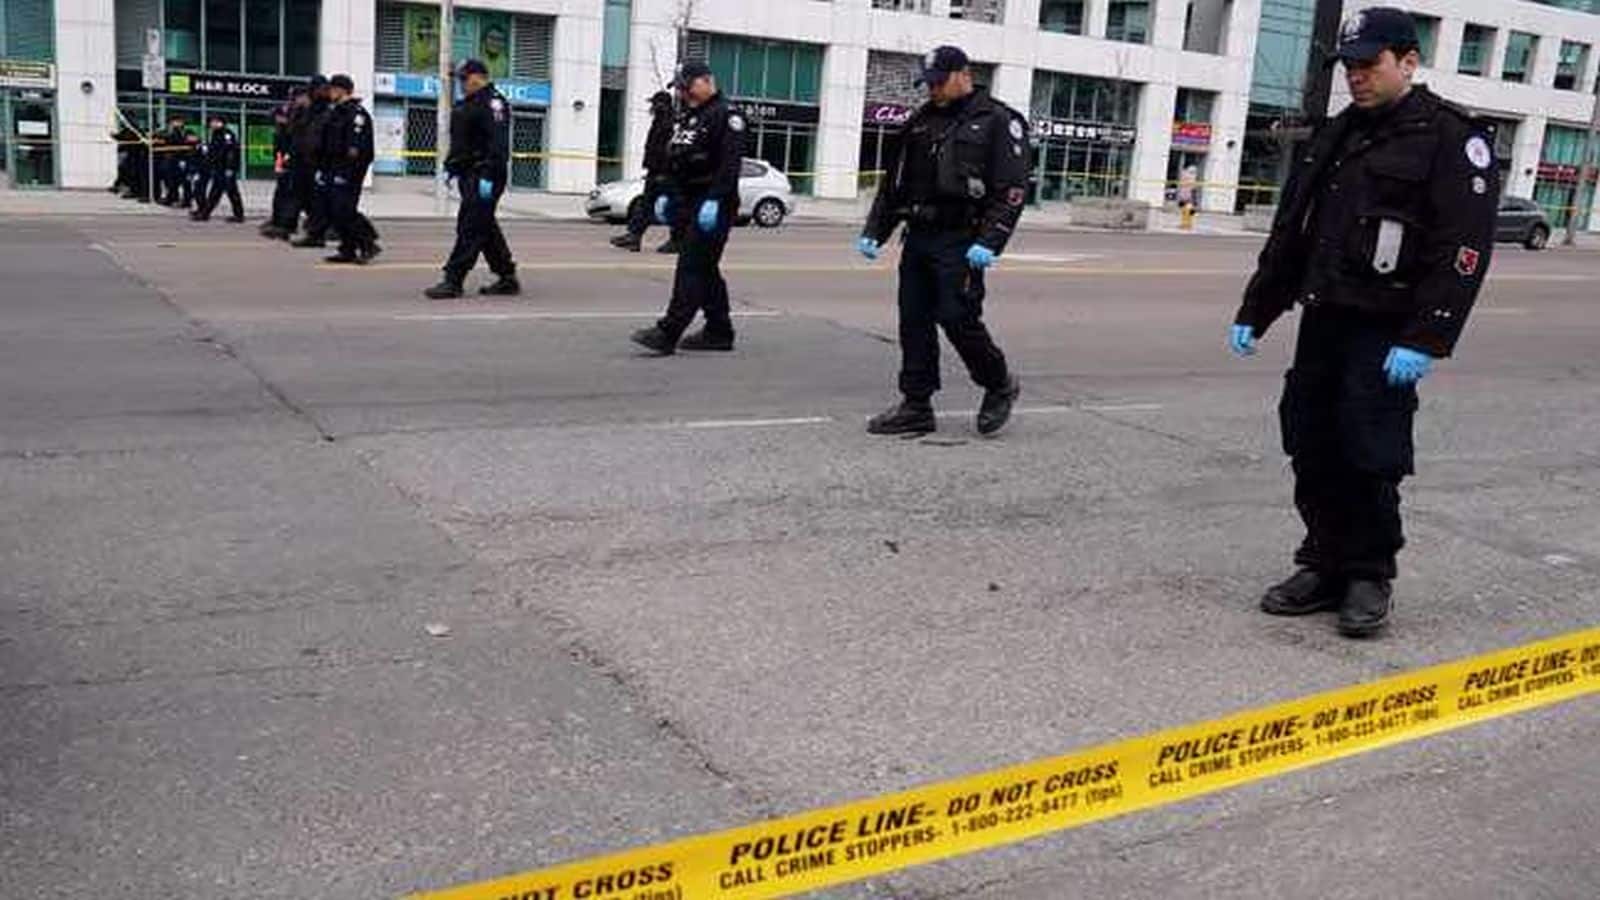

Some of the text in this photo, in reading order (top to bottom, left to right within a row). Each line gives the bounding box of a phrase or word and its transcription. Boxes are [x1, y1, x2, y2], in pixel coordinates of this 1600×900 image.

[227, 82, 270, 95] BLOCK
[1464, 659, 1530, 692] POLICE
[1457, 694, 1482, 710] CALL
[1157, 684, 1438, 767] POLICE LINE- DO NOT CROSS
[1149, 769, 1182, 788] CALL
[1189, 754, 1232, 778] CRIME
[730, 760, 1120, 865] POLICE LINE- DO NOT CROSS
[572, 861, 676, 899] CROSS
[719, 866, 766, 889] CALL
[776, 849, 836, 878] CRIME
